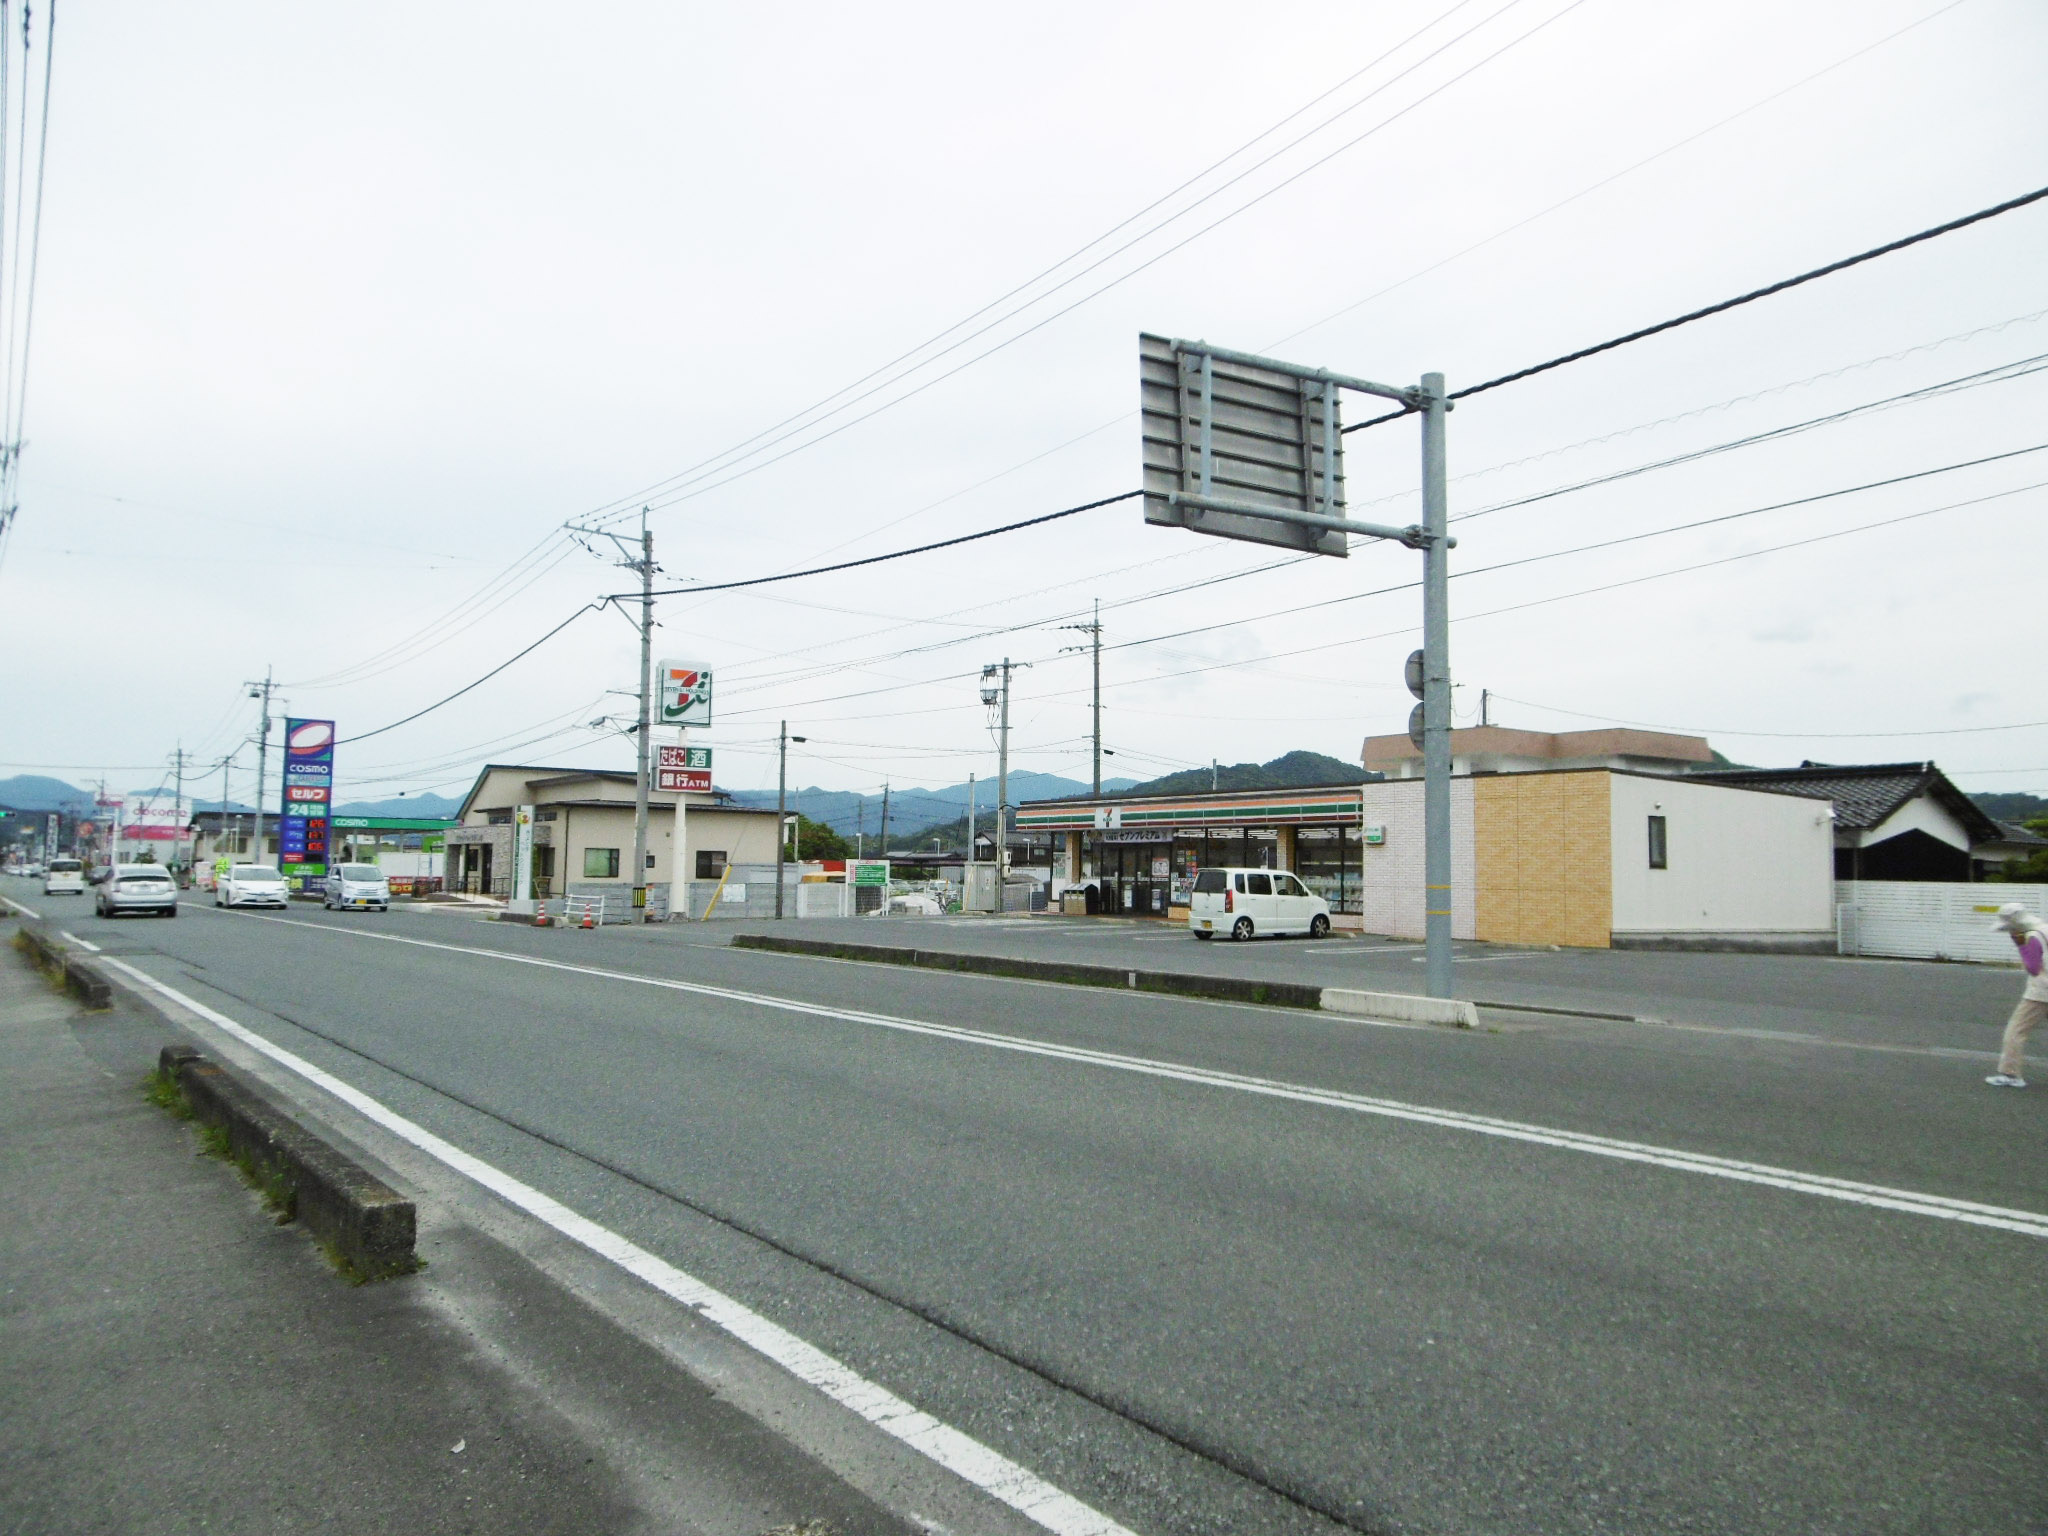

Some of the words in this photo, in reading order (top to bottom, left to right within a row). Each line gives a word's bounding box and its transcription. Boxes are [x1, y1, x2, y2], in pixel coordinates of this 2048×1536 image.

[660, 748, 685, 766] たばこ
[690, 749, 706, 767] 酒
[289, 764, 328, 774] COSMO
[291, 788, 325, 799] セルフ
[289, 803, 309, 816] 24
[335, 818, 368, 827] COSMO
